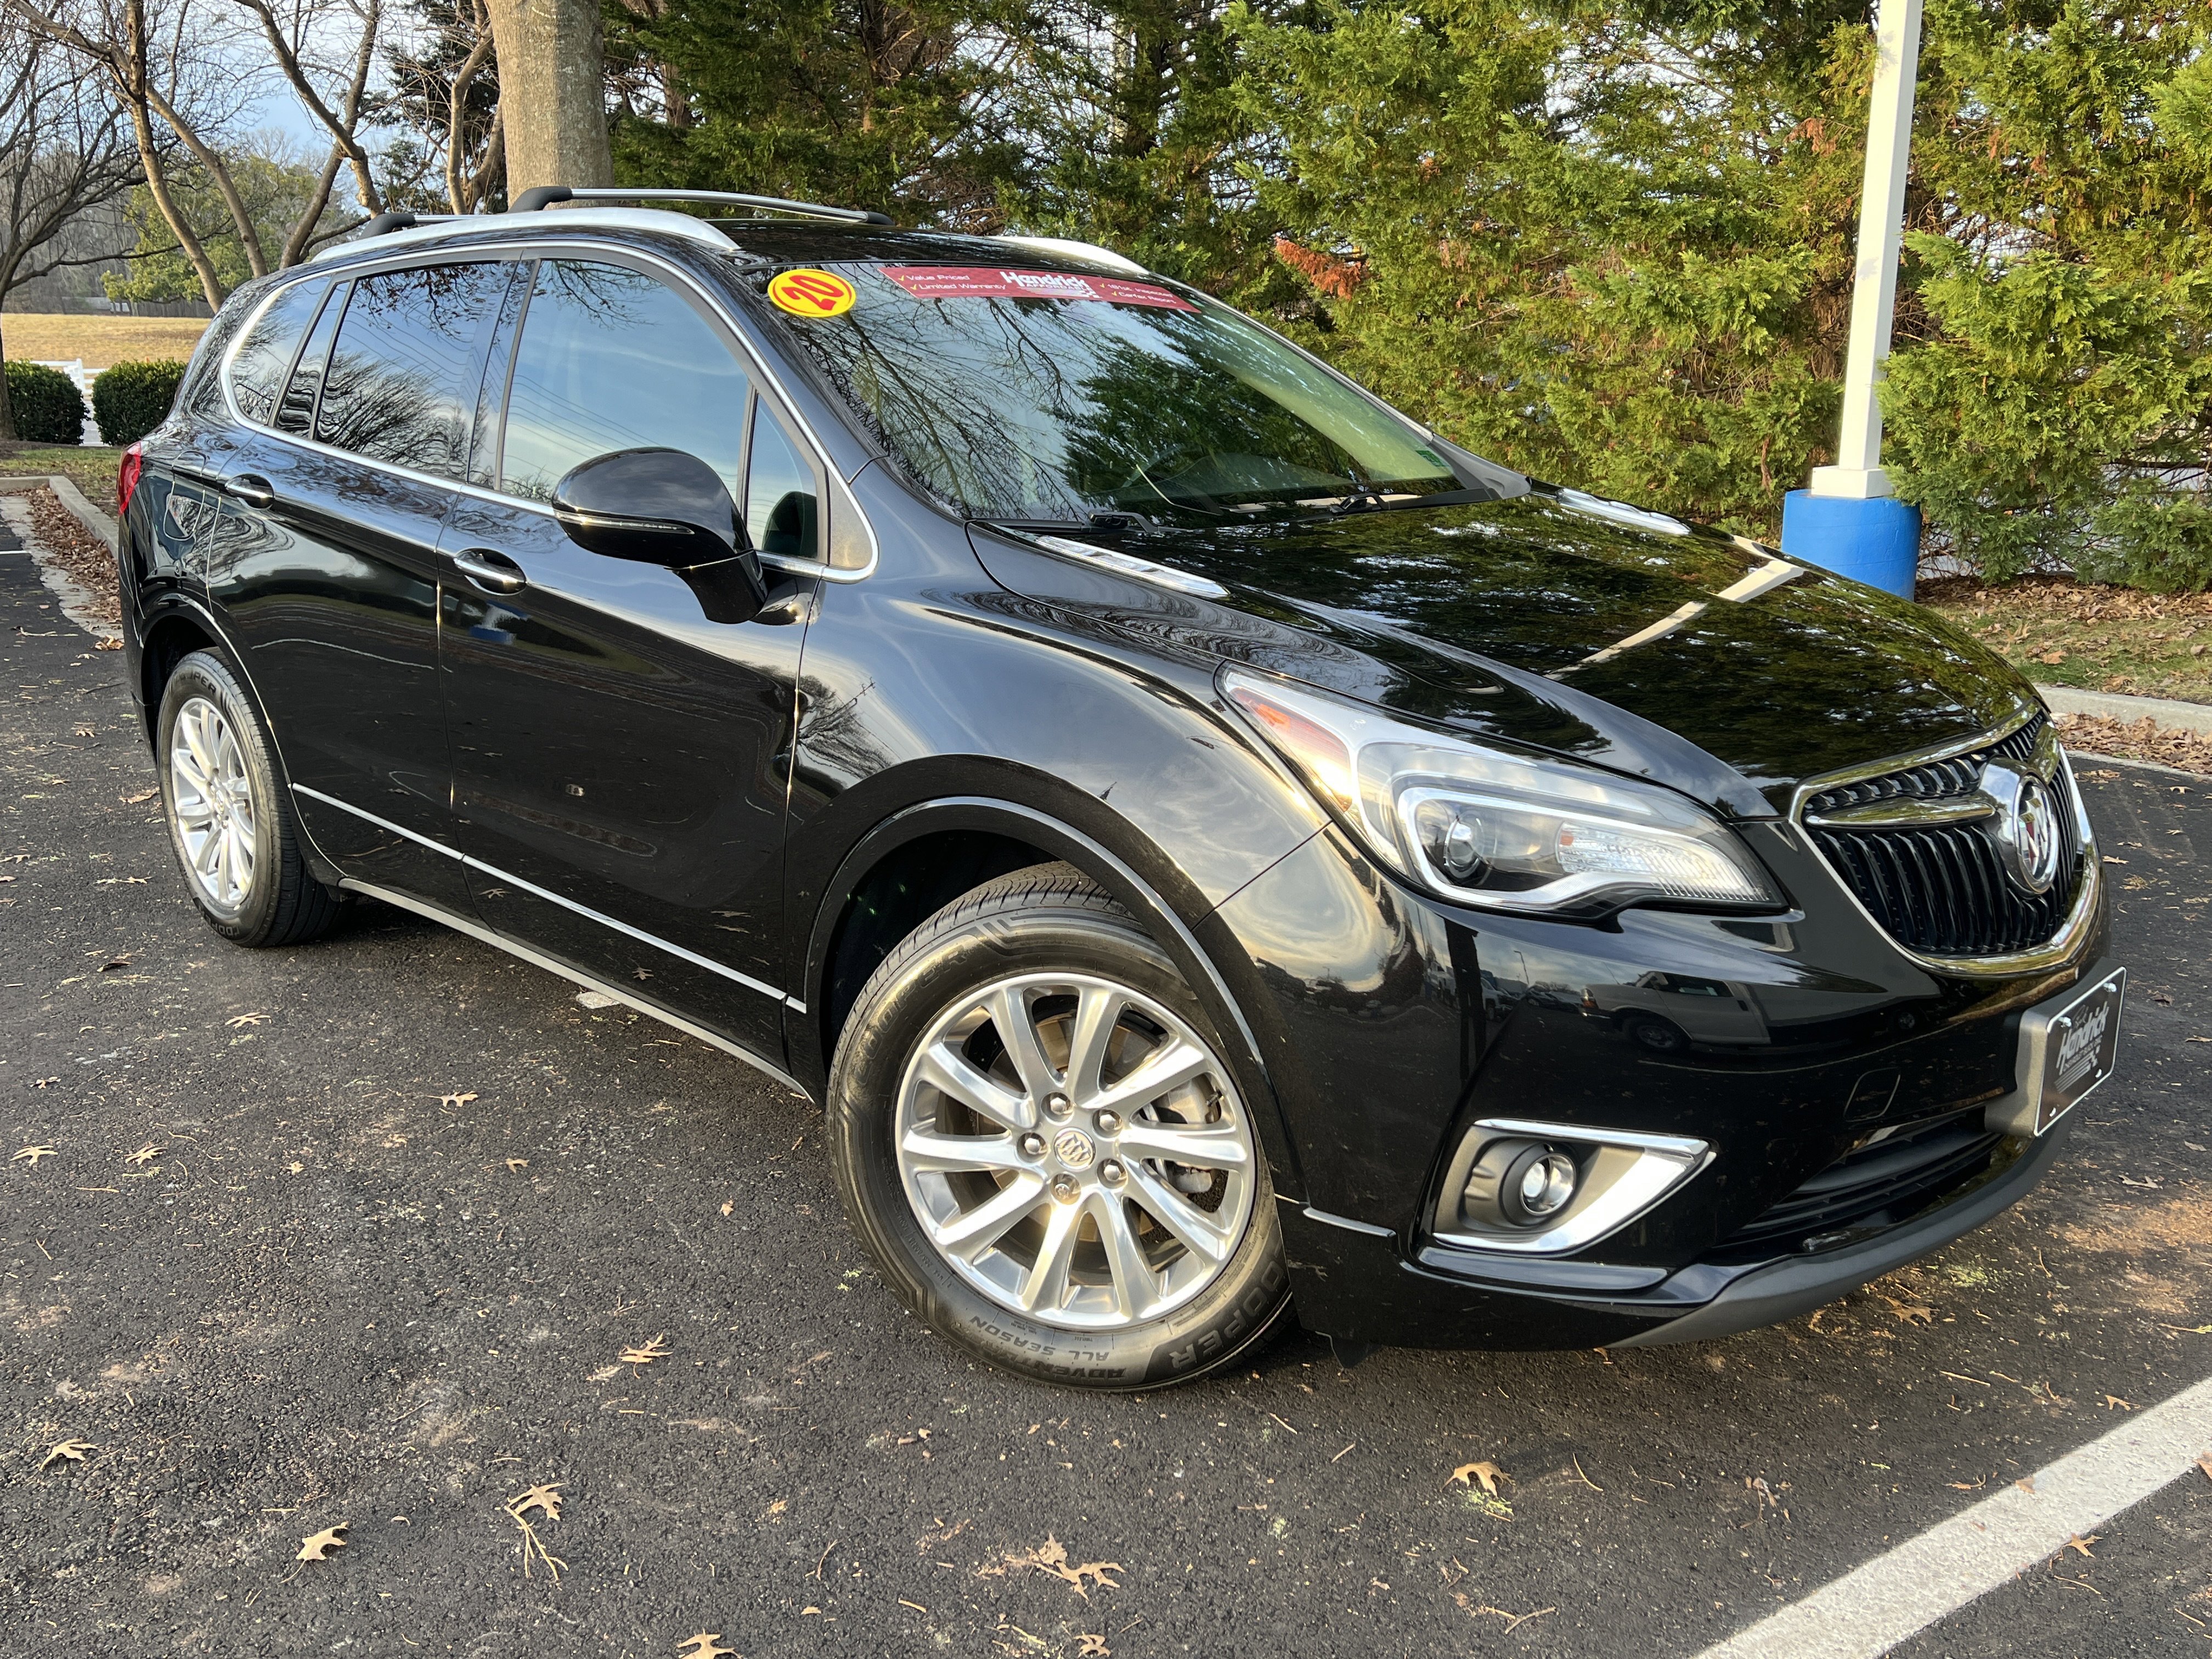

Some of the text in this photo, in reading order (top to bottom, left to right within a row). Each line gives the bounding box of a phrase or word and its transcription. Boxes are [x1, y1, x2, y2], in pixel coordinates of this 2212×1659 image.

[1000, 271, 1090, 287] Hendrick
[781, 275, 844, 311] 20
[970, 1316, 1056, 1356] SEASON
[1069, 1350, 1109, 1361] ALL
